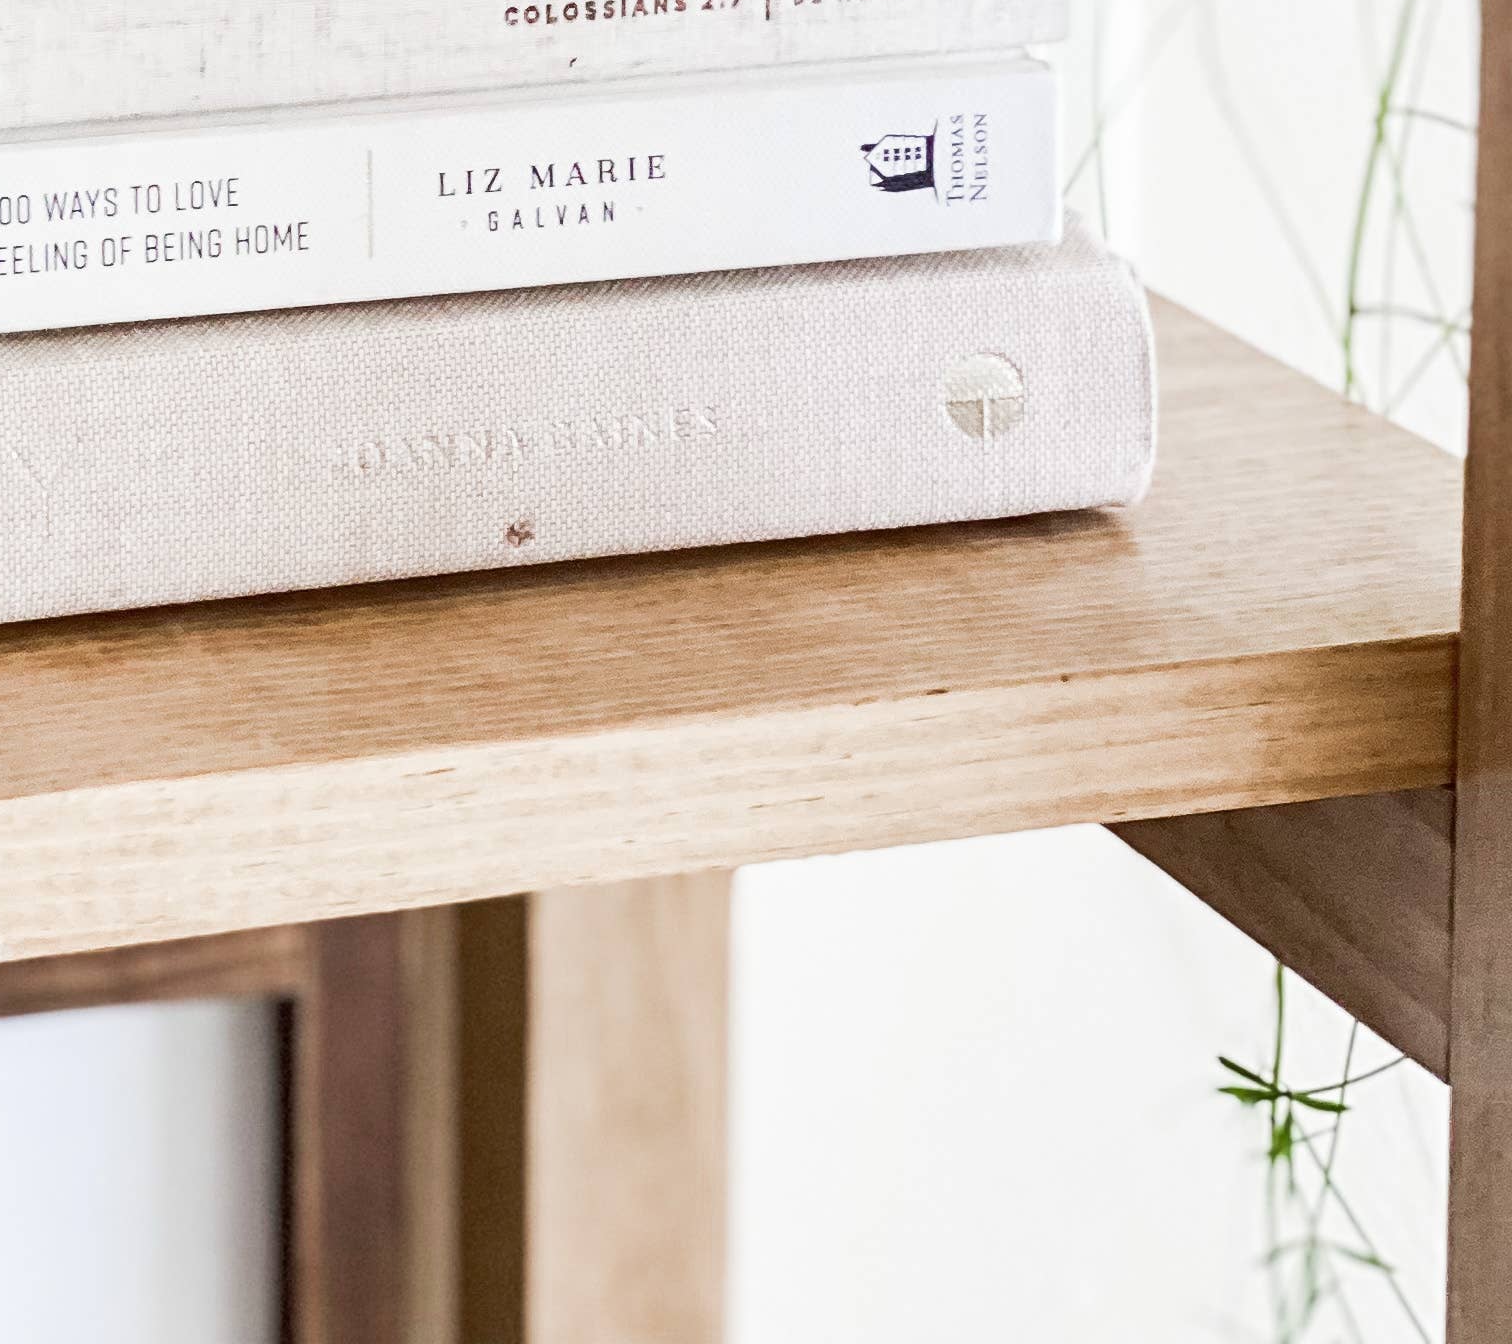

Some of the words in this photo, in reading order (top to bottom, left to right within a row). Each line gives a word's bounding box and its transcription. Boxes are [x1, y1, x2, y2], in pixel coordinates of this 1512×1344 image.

[438, 167, 503, 197] LIZ
[530, 154, 669, 190] MARIE
[44, 187, 118, 222] WAYS
[131, 184, 161, 214] TO
[175, 177, 240, 211] LOVE
[488, 200, 615, 232] GALVAN
[101, 236, 133, 266] OF
[145, 228, 222, 263] BEING
[235, 221, 310, 255] HOME
